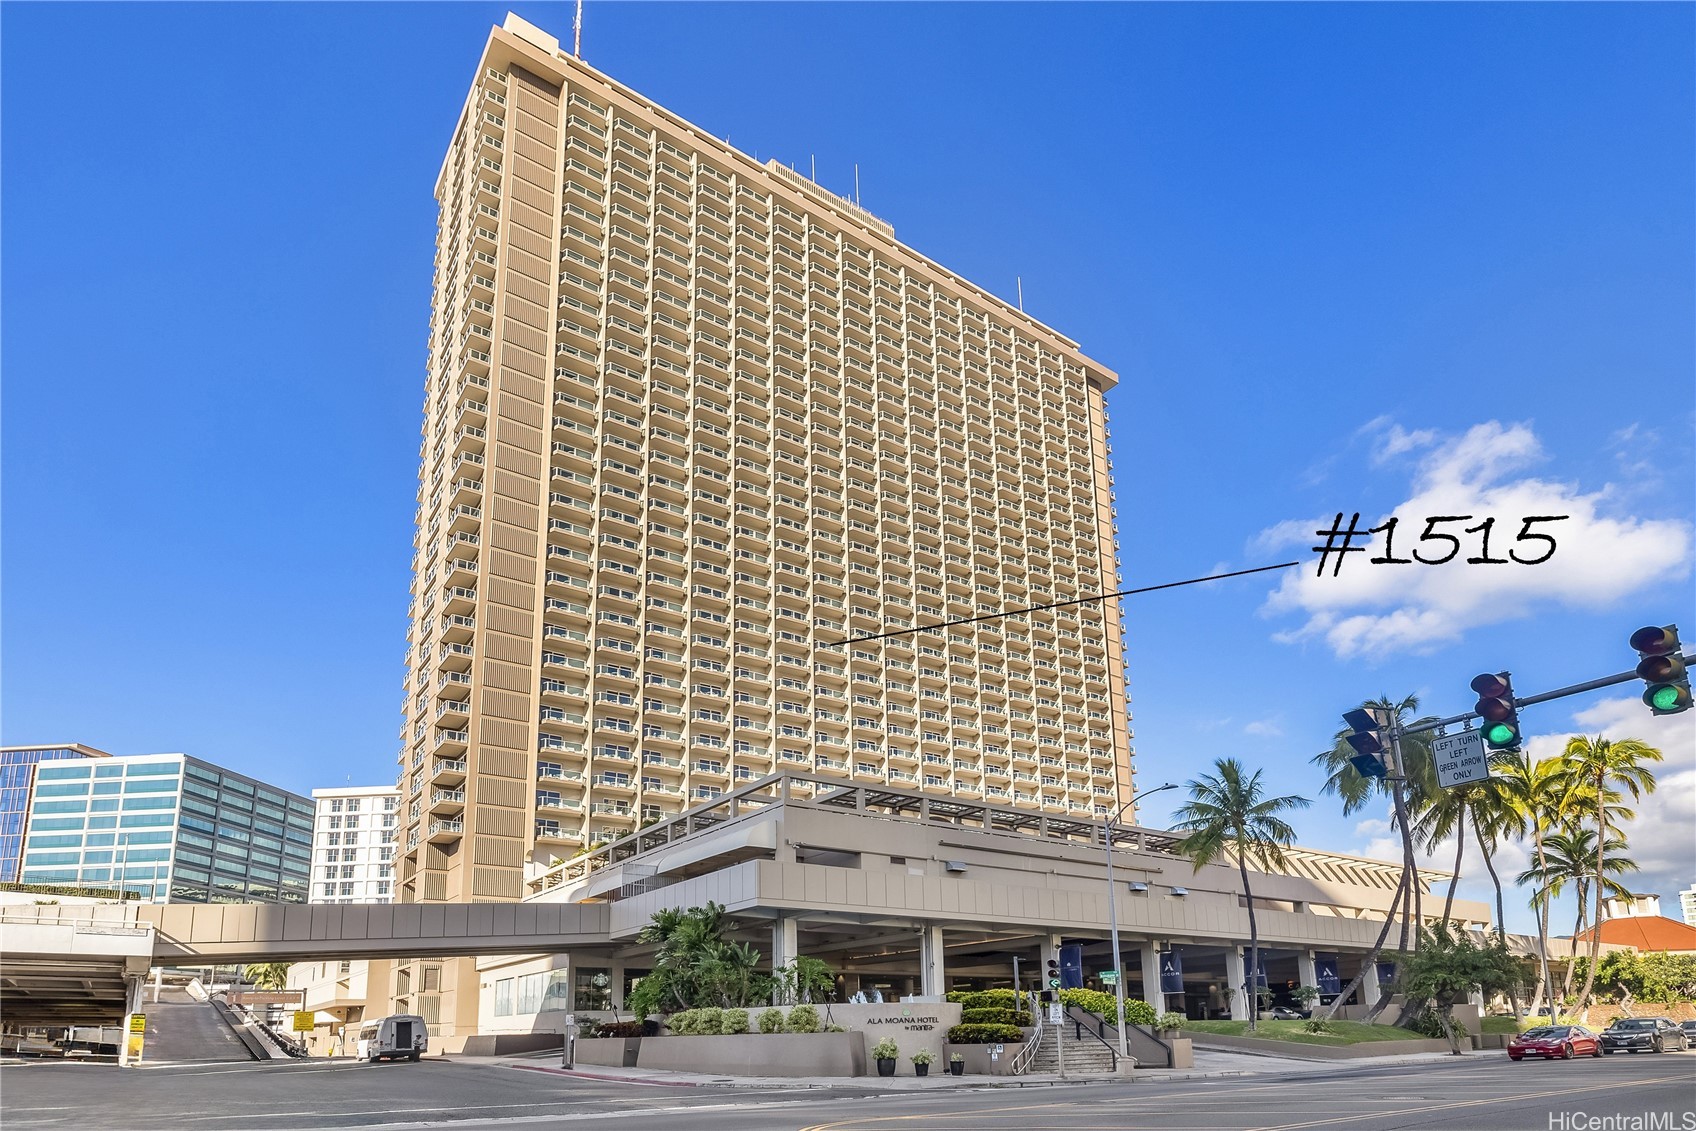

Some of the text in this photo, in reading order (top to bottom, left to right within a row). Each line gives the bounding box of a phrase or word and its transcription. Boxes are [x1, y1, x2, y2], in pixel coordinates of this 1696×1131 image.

[1436, 734, 1479, 751] LEFT TURN
[1449, 748, 1468, 759] LEFT
[1439, 756, 1481, 773] GREEN ARROW
[1453, 769, 1472, 780] ONLY
